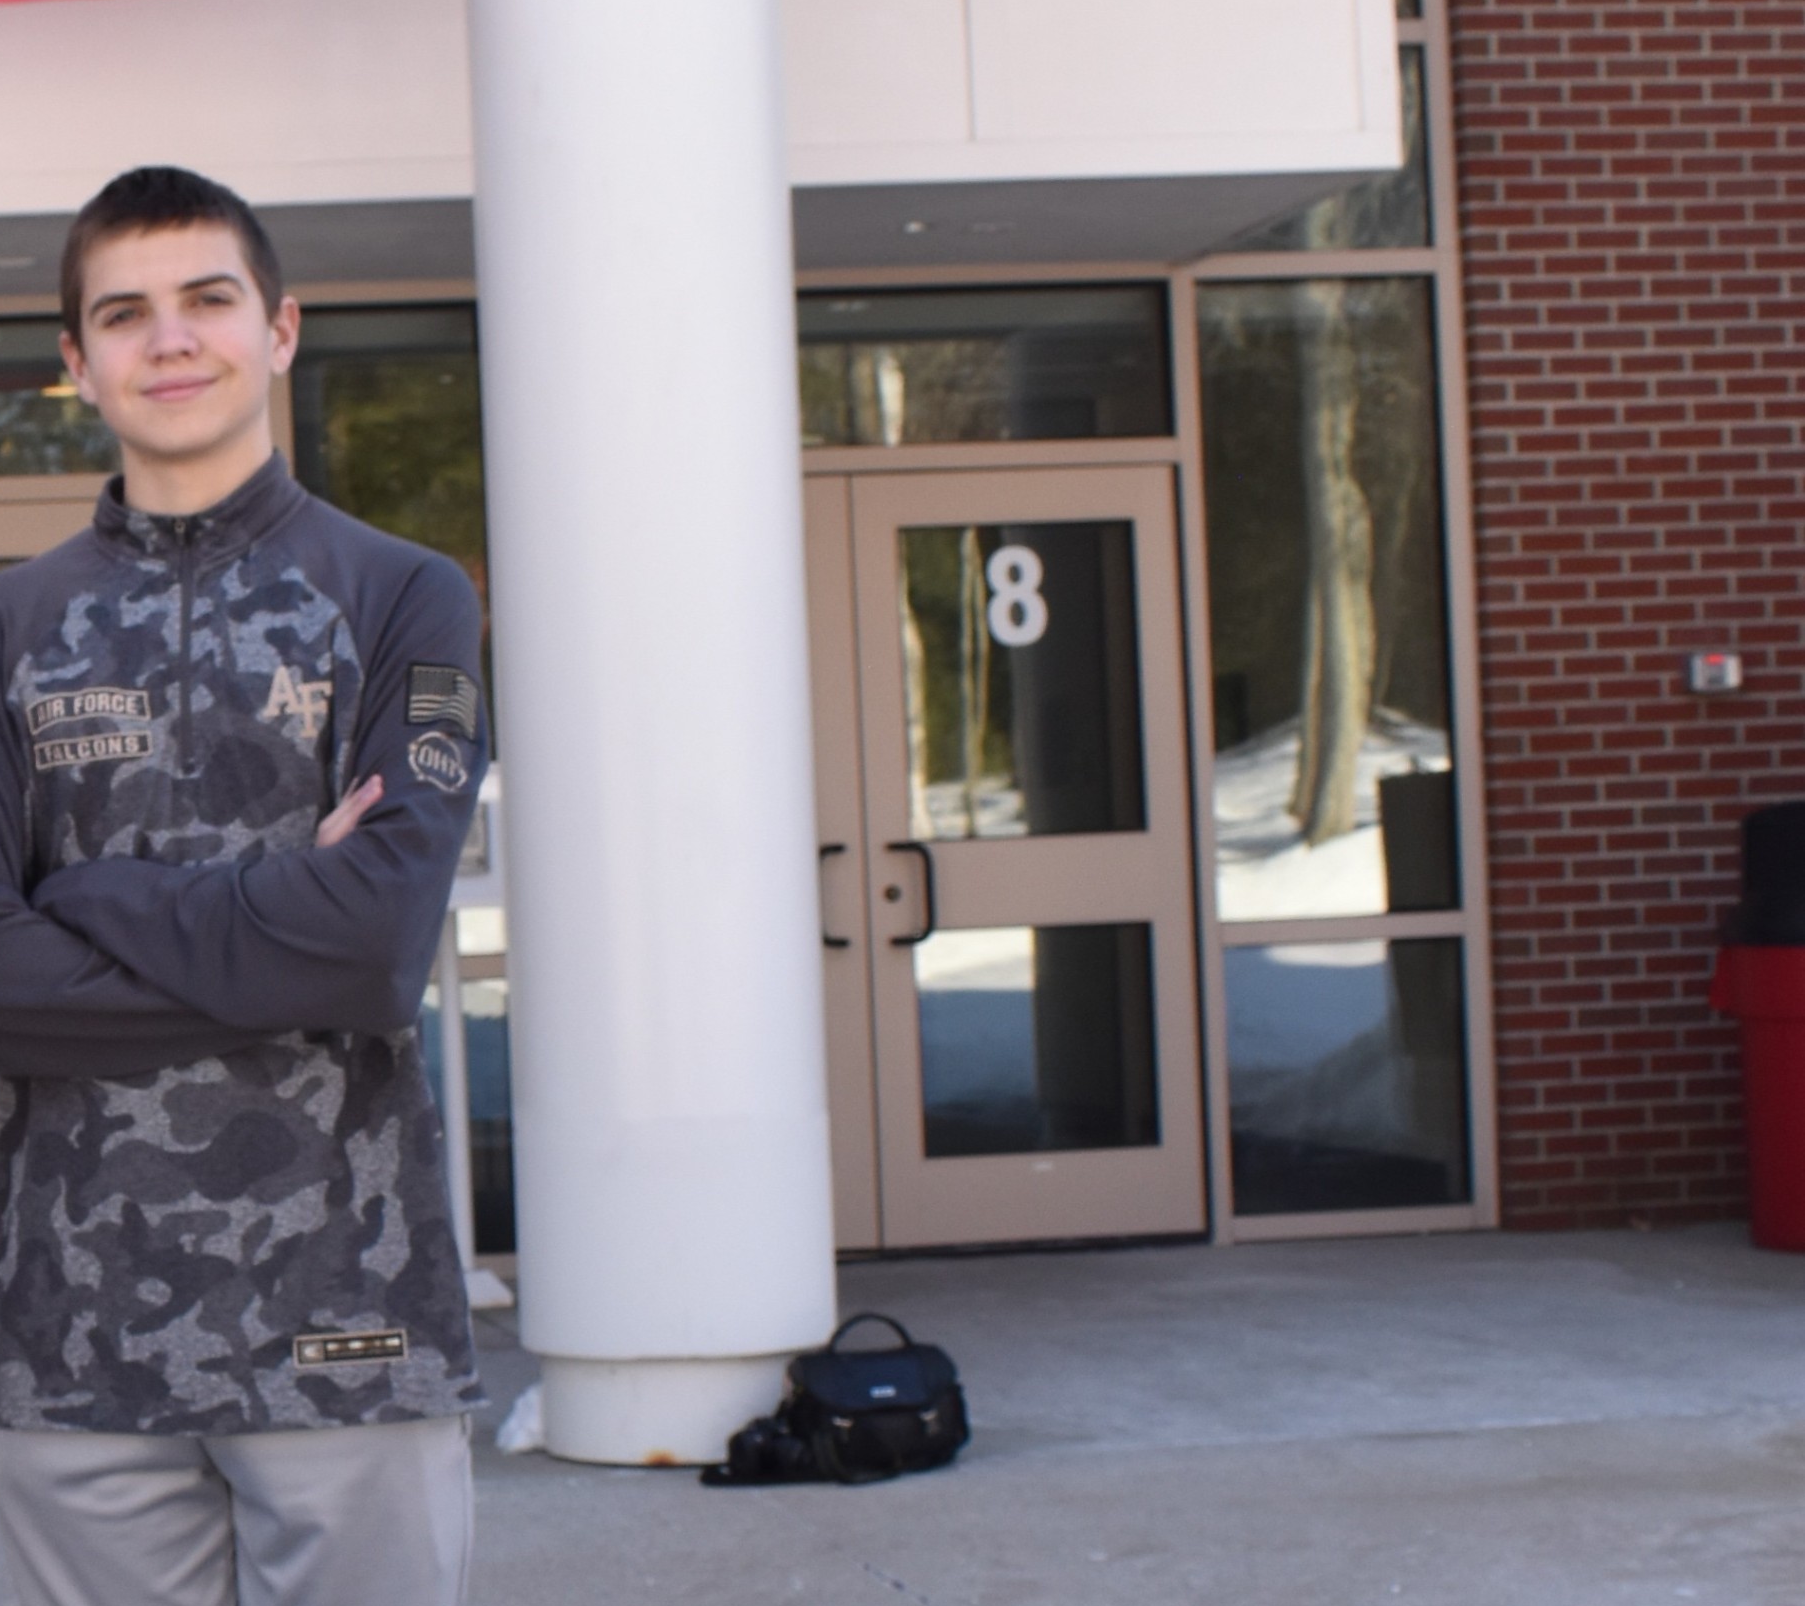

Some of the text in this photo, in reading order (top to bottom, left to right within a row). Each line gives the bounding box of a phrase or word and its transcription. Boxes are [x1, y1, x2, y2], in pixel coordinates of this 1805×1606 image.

[988, 547, 1048, 646] 8
[36, 691, 139, 725] AIR FORCE
[262, 665, 333, 739] AF
[43, 735, 141, 763] FALCONS
